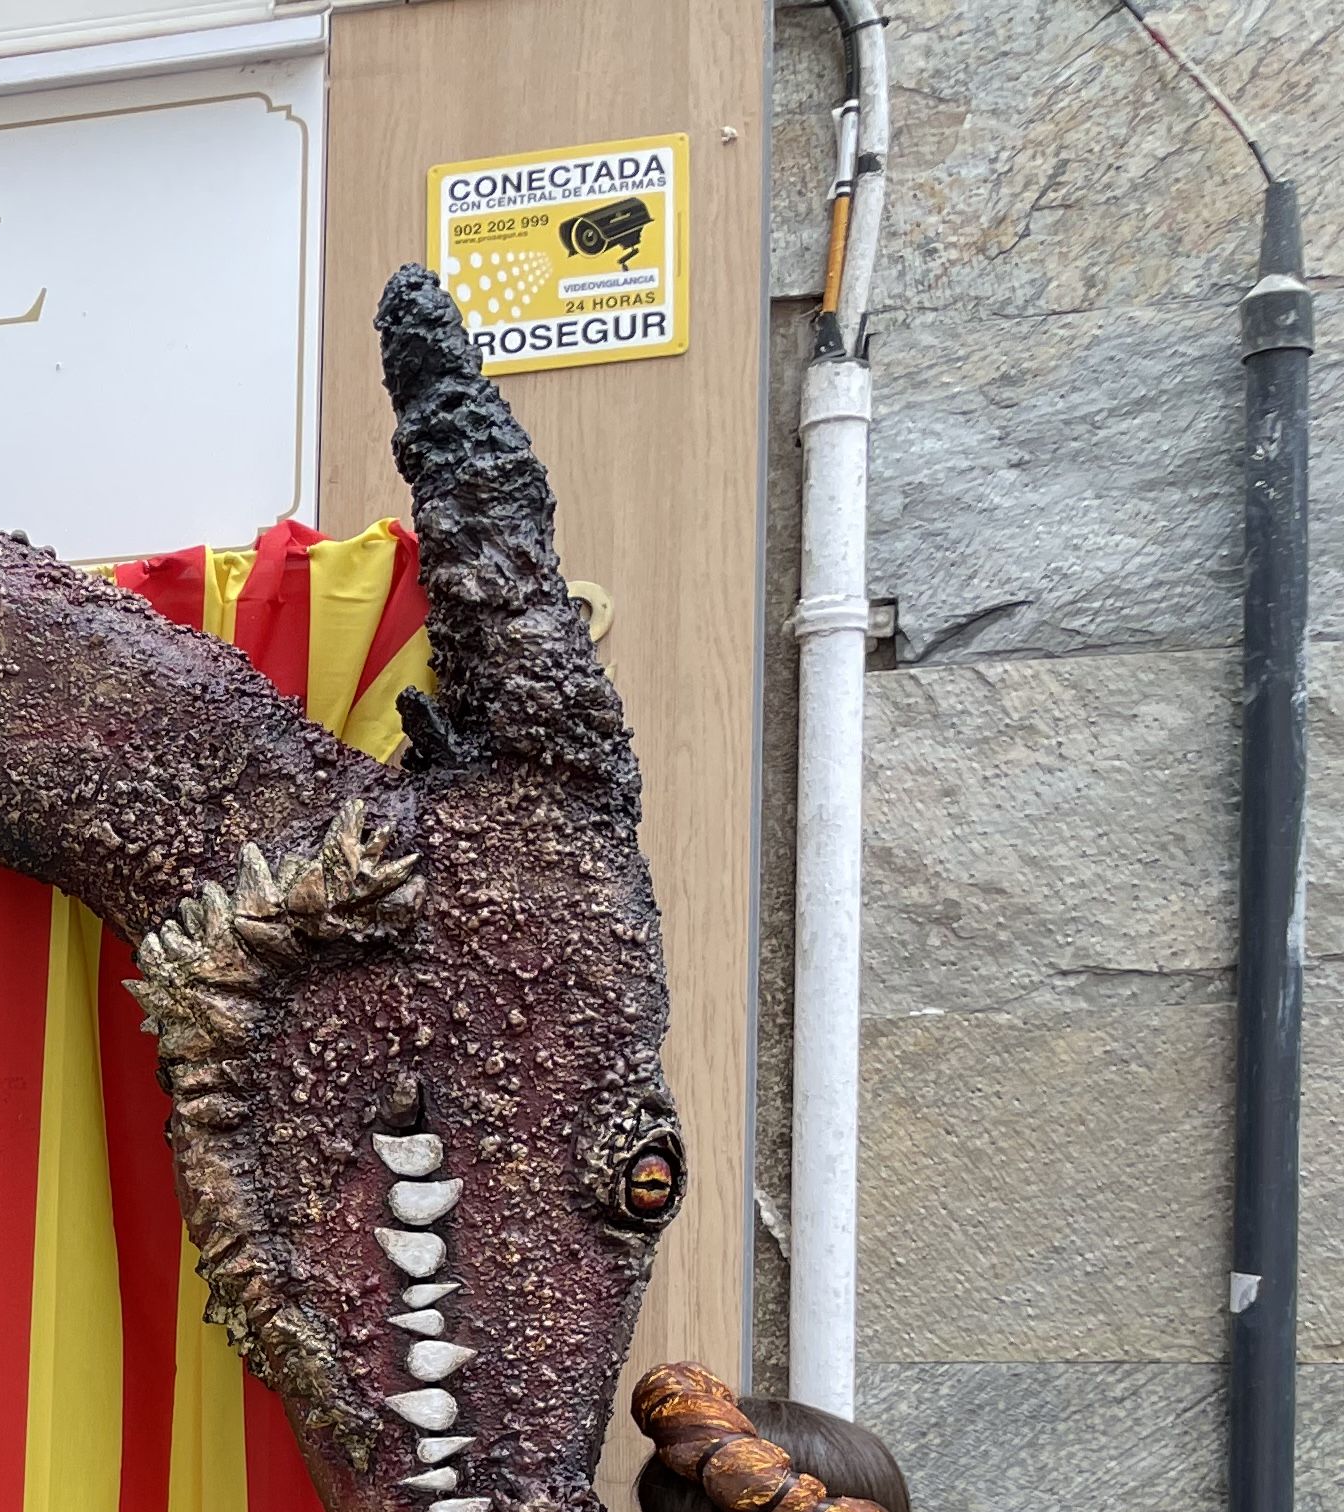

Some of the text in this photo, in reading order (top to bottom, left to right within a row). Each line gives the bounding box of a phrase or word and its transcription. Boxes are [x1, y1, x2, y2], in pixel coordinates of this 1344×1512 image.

[448, 154, 665, 201] CONECTADA
[448, 176, 667, 213] CON CENTRAL DE ALARMAS
[454, 214, 549, 237] 902 202 999
[563, 274, 655, 293] VIDEOVIGILANCIA
[565, 291, 656, 314] 24 HORAS
[472, 311, 666, 356] ROSEGUR
